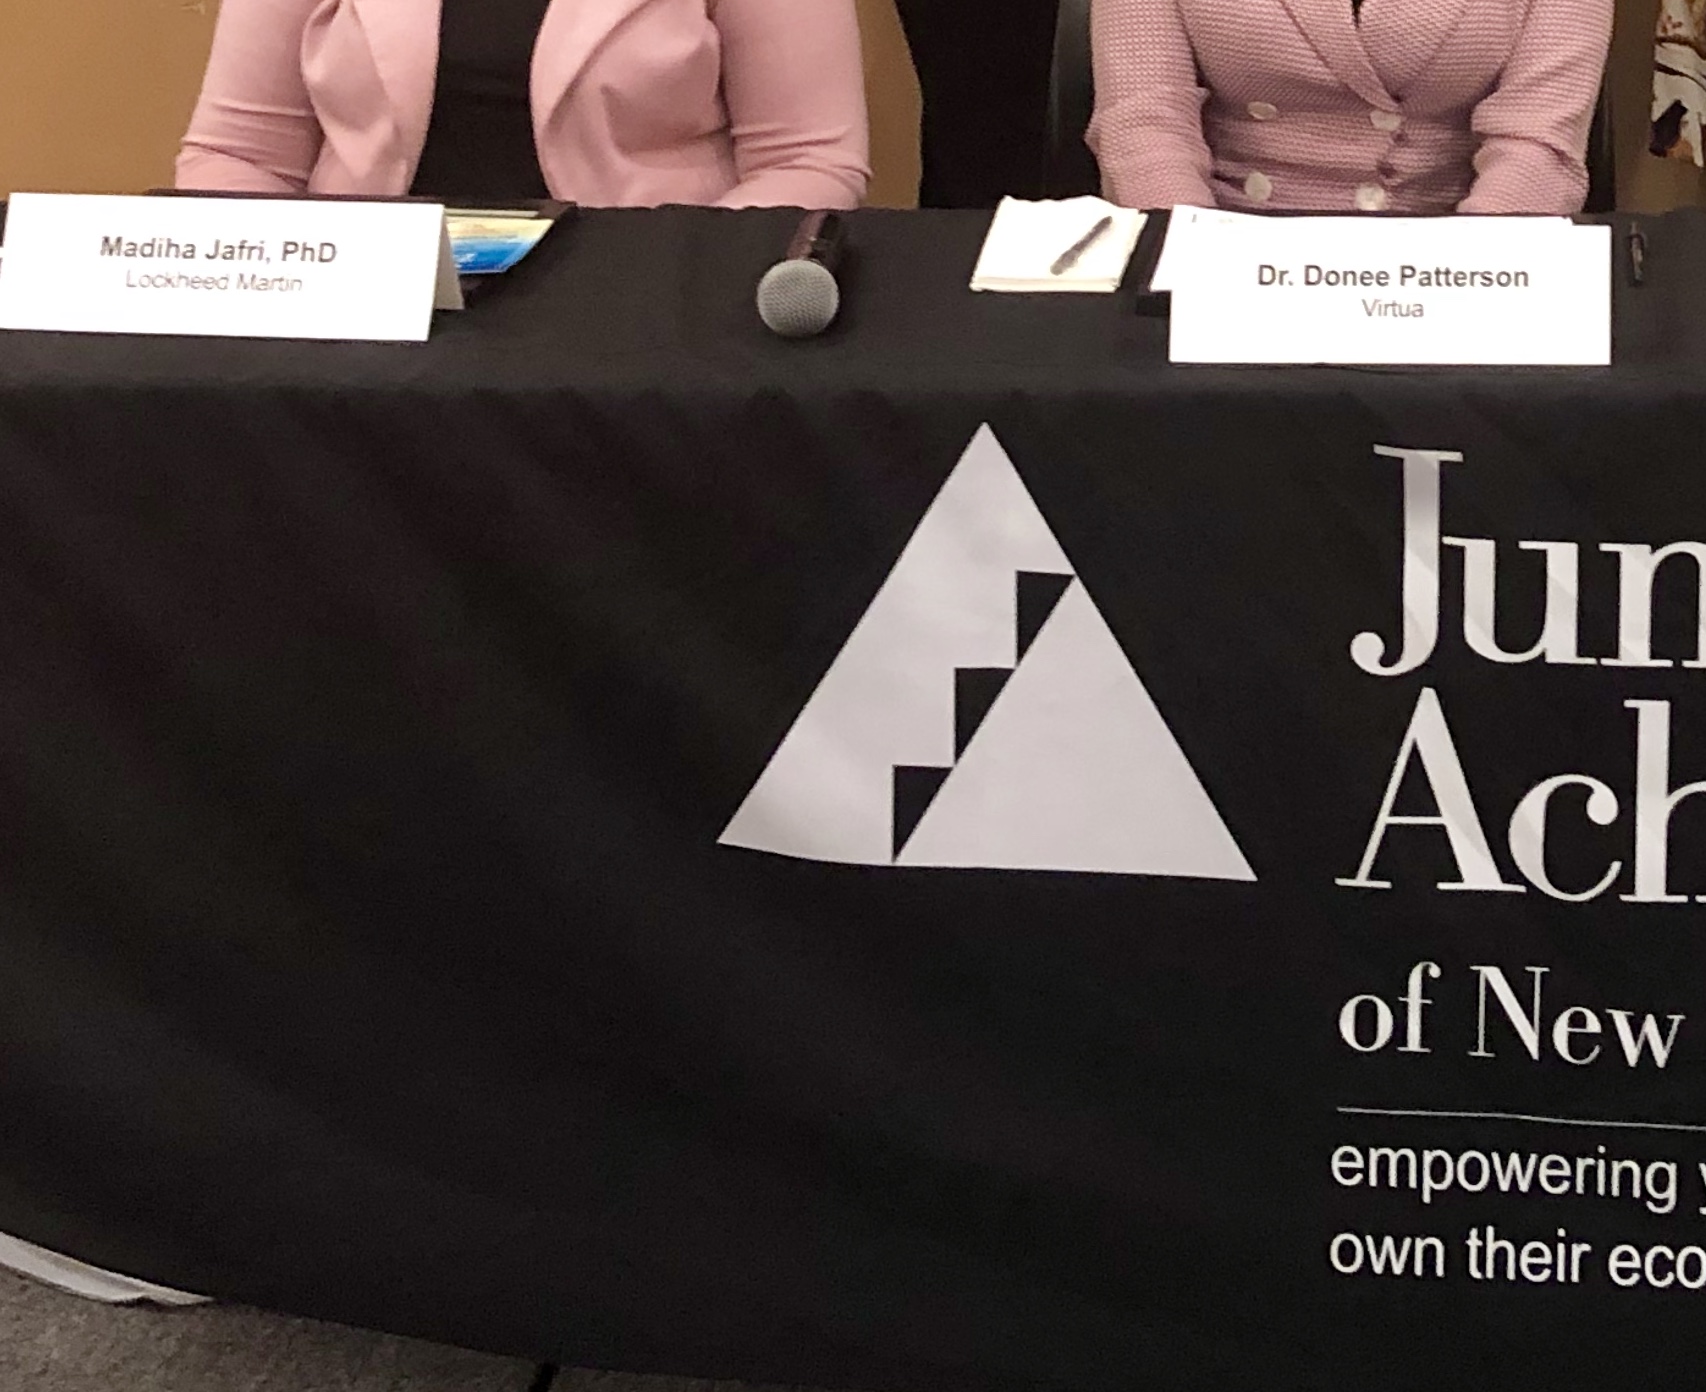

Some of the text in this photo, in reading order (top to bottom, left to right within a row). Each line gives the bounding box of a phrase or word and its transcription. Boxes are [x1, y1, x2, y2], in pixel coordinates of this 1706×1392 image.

[100, 235, 338, 264] Madiha Jafri, PhD
[126, 270, 302, 292] Lockheed Martin
[1257, 264, 1529, 287] Dr. Donee Patterson
[1361, 299, 1424, 318] Virtua
[1339, 962, 1441, 1052] of
[1469, 966, 1685, 1068] New
[1331, 1146, 1676, 1213] empowering
[1330, 1233, 1444, 1277] own
[1466, 1226, 1591, 1282] their
